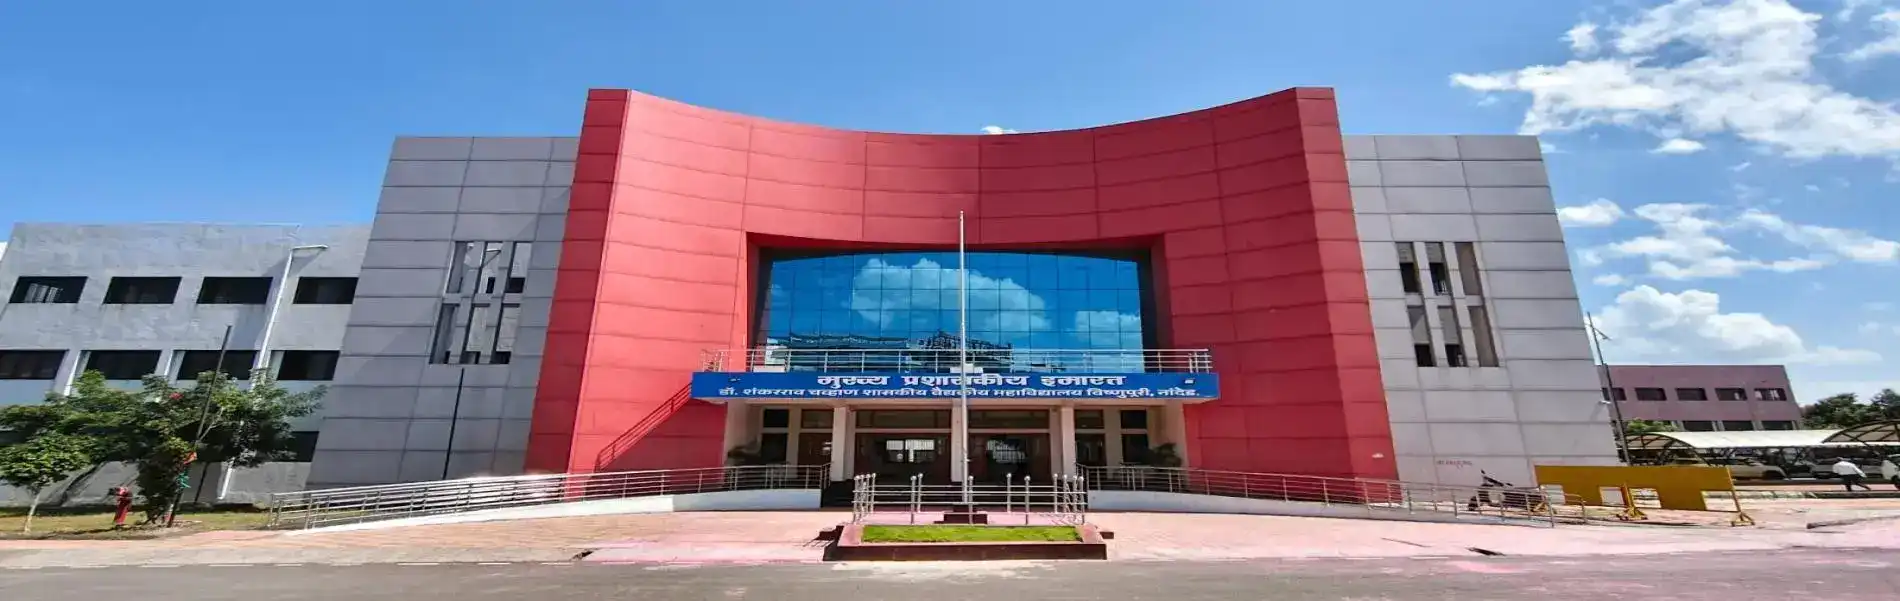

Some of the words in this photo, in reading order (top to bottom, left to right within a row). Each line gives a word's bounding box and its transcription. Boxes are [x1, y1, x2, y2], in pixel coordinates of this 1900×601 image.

[817, 376, 890, 388] मुख्य
[901, 373, 1030, 386] प्रशासकीय
[1040, 376, 1127, 386] इमारत
[718, 386, 738, 395] डॉ.
[743, 387, 805, 396] शंकरराव
[808, 388, 860, 396] चव्हाण
[862, 387, 927, 396] शासकीय
[994, 387, 1083, 396] महाविद्यालय
